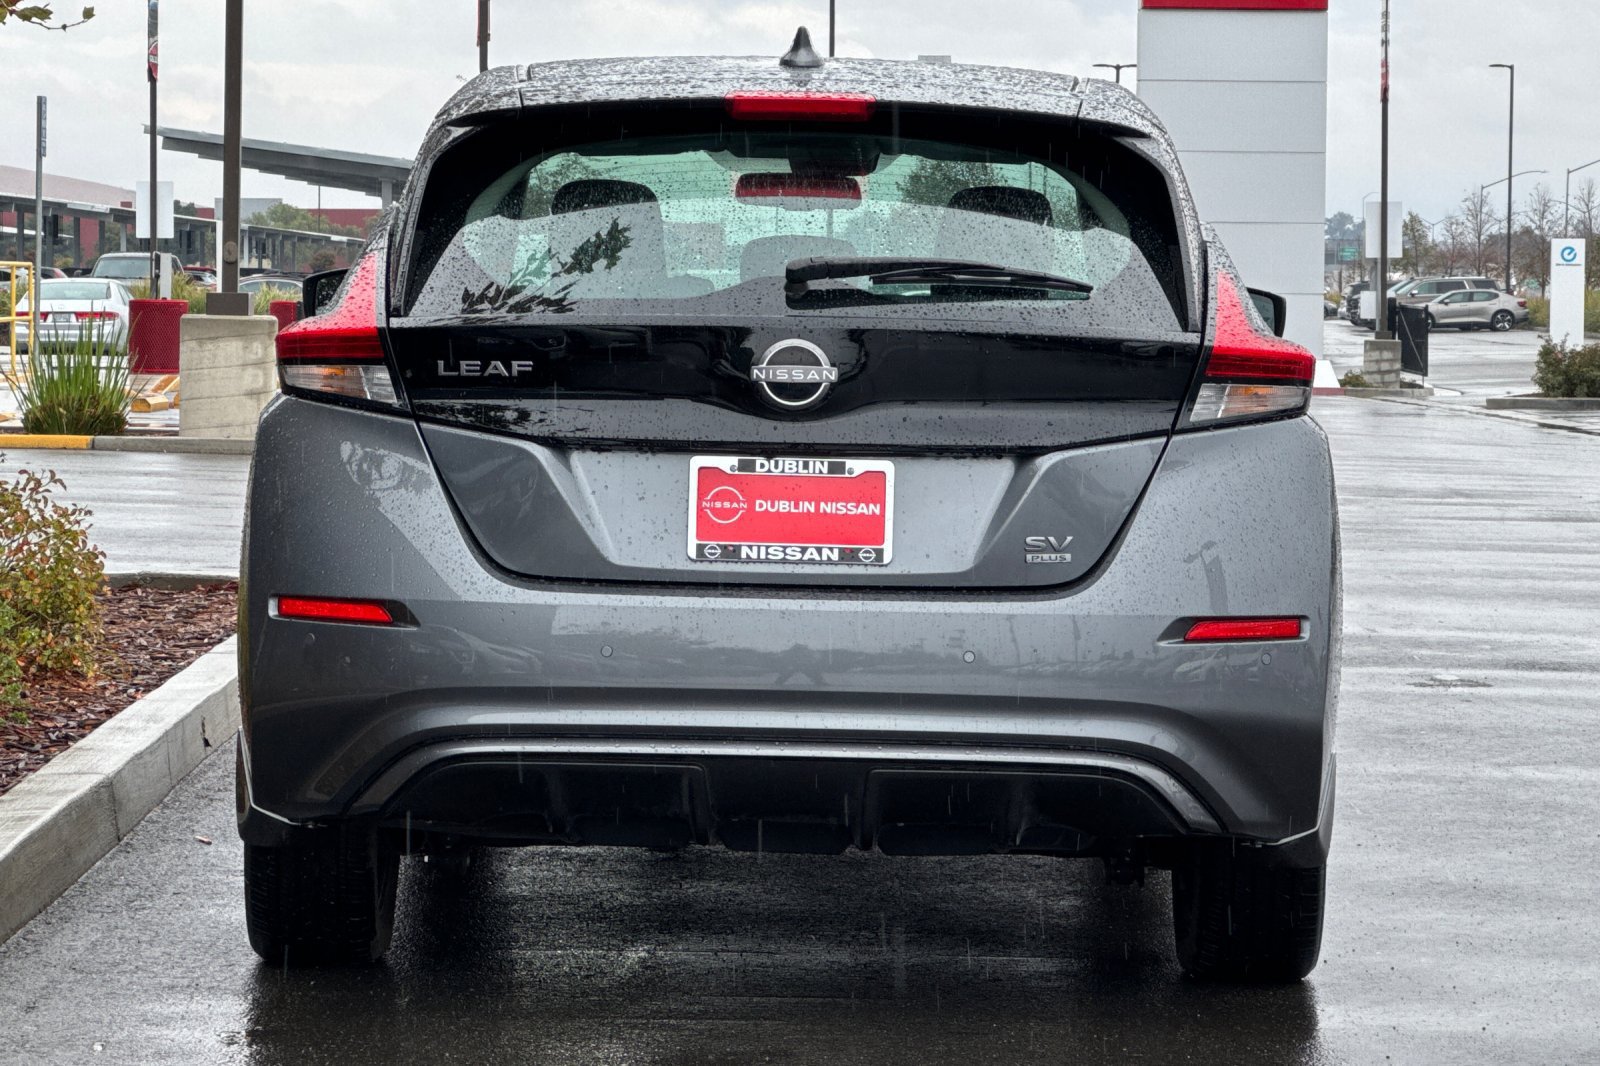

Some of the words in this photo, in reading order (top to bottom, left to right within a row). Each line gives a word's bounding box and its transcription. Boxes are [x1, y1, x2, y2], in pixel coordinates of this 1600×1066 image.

[437, 360, 534, 377] LEAF
[753, 368, 836, 380] NISSAN
[755, 459, 829, 474] DUBLIN
[702, 501, 747, 509] NISSAN
[755, 500, 815, 513] DUBLIN
[819, 501, 881, 515] NISSAN
[1025, 536, 1074, 551] SV
[741, 546, 839, 561] NISSAN
[1029, 554, 1069, 562] PLUS
